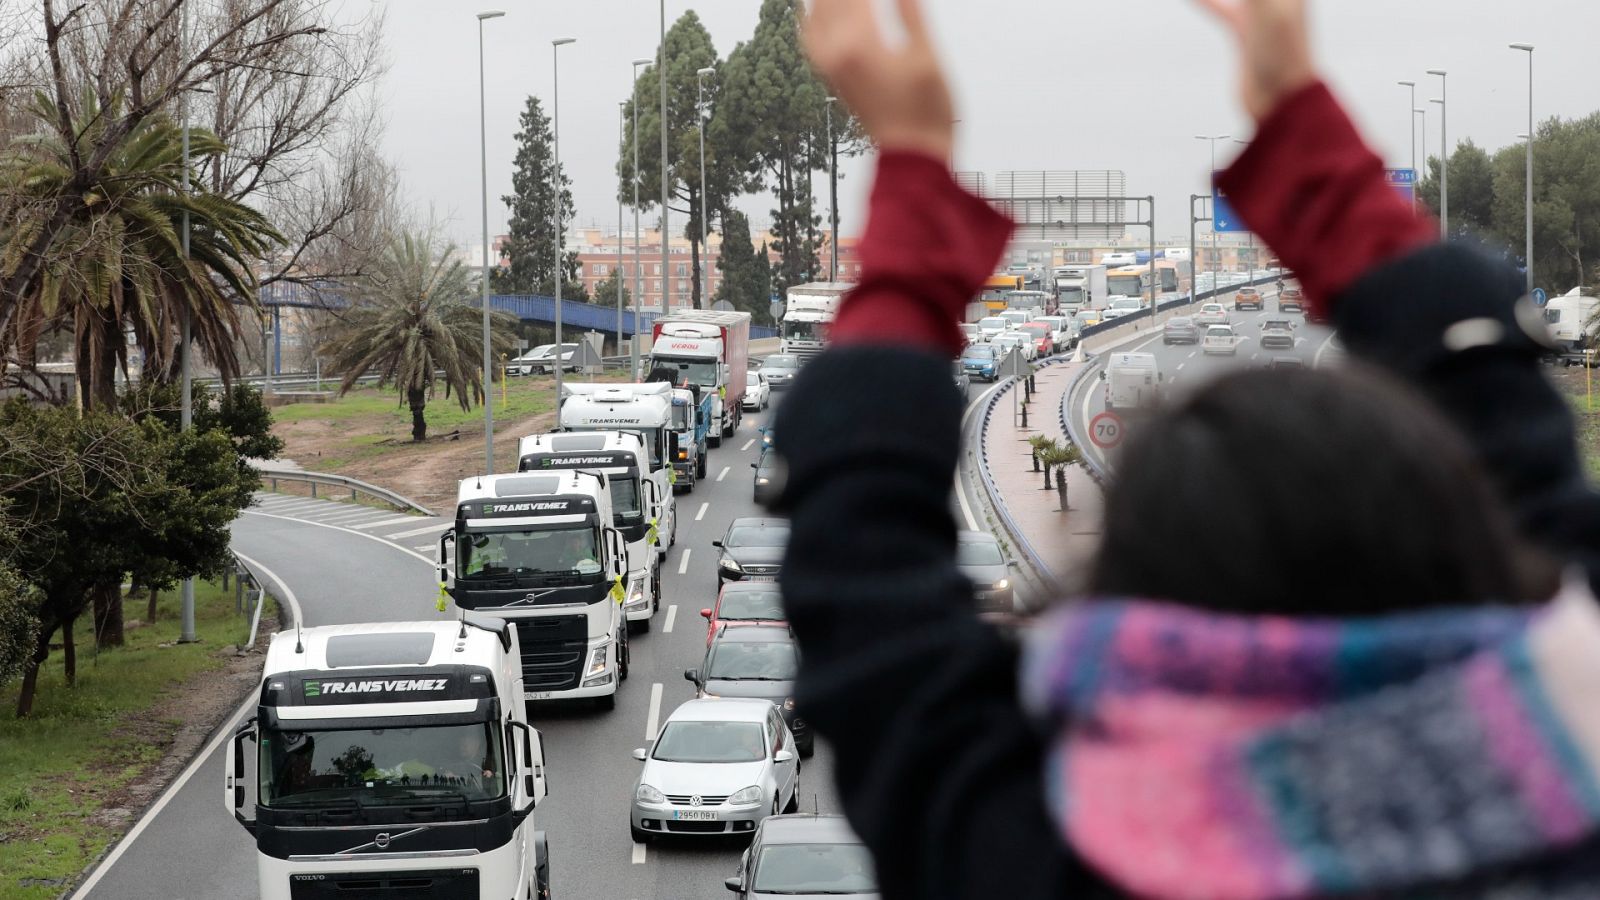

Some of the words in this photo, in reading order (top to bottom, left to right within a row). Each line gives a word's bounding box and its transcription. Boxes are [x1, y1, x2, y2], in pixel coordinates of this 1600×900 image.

[1097, 424, 1117, 437] 70
[550, 456, 614, 466] TRANSVEMEZ
[493, 501, 568, 513] TRANSVEMEZ
[321, 678, 448, 695] TRANSVEMEZ
[678, 811, 699, 820] 2950
